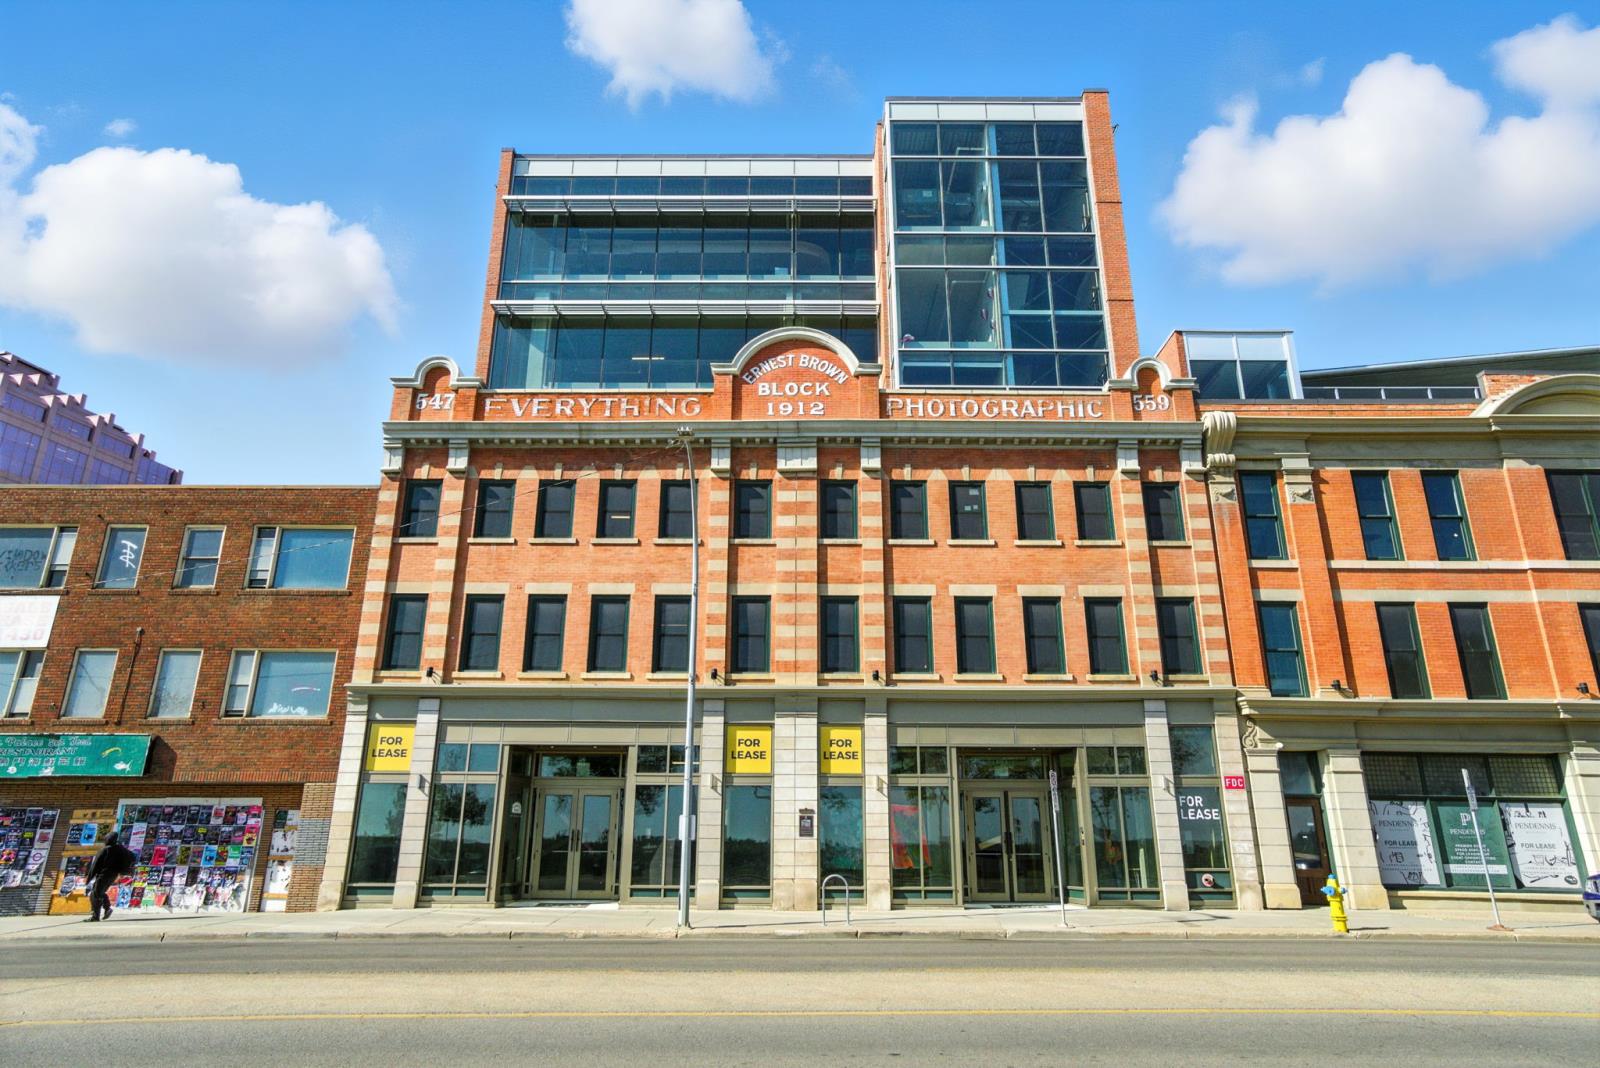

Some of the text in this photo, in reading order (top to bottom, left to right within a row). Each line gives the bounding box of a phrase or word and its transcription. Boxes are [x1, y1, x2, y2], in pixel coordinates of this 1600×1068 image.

[742, 354, 849, 385] ERNEST BROWN
[758, 382, 831, 396] BLOCK
[416, 393, 456, 410] 547
[484, 397, 702, 417] EVERYTHING
[1133, 394, 1170, 411] 559
[767, 401, 825, 416] 1912
[886, 398, 1103, 418] PHOTOGRAPHIC
[379, 737, 403, 745] FOR
[738, 738, 761, 747] FOR
[829, 739, 852, 747] FOR
[371, 749, 408, 757] LEASE
[731, 751, 767, 760] LEASE
[823, 751, 859, 760] LEASE
[1225, 778, 1244, 787] FDC
[1179, 795, 1203, 807] FOR
[1180, 809, 1220, 820] LEASE
